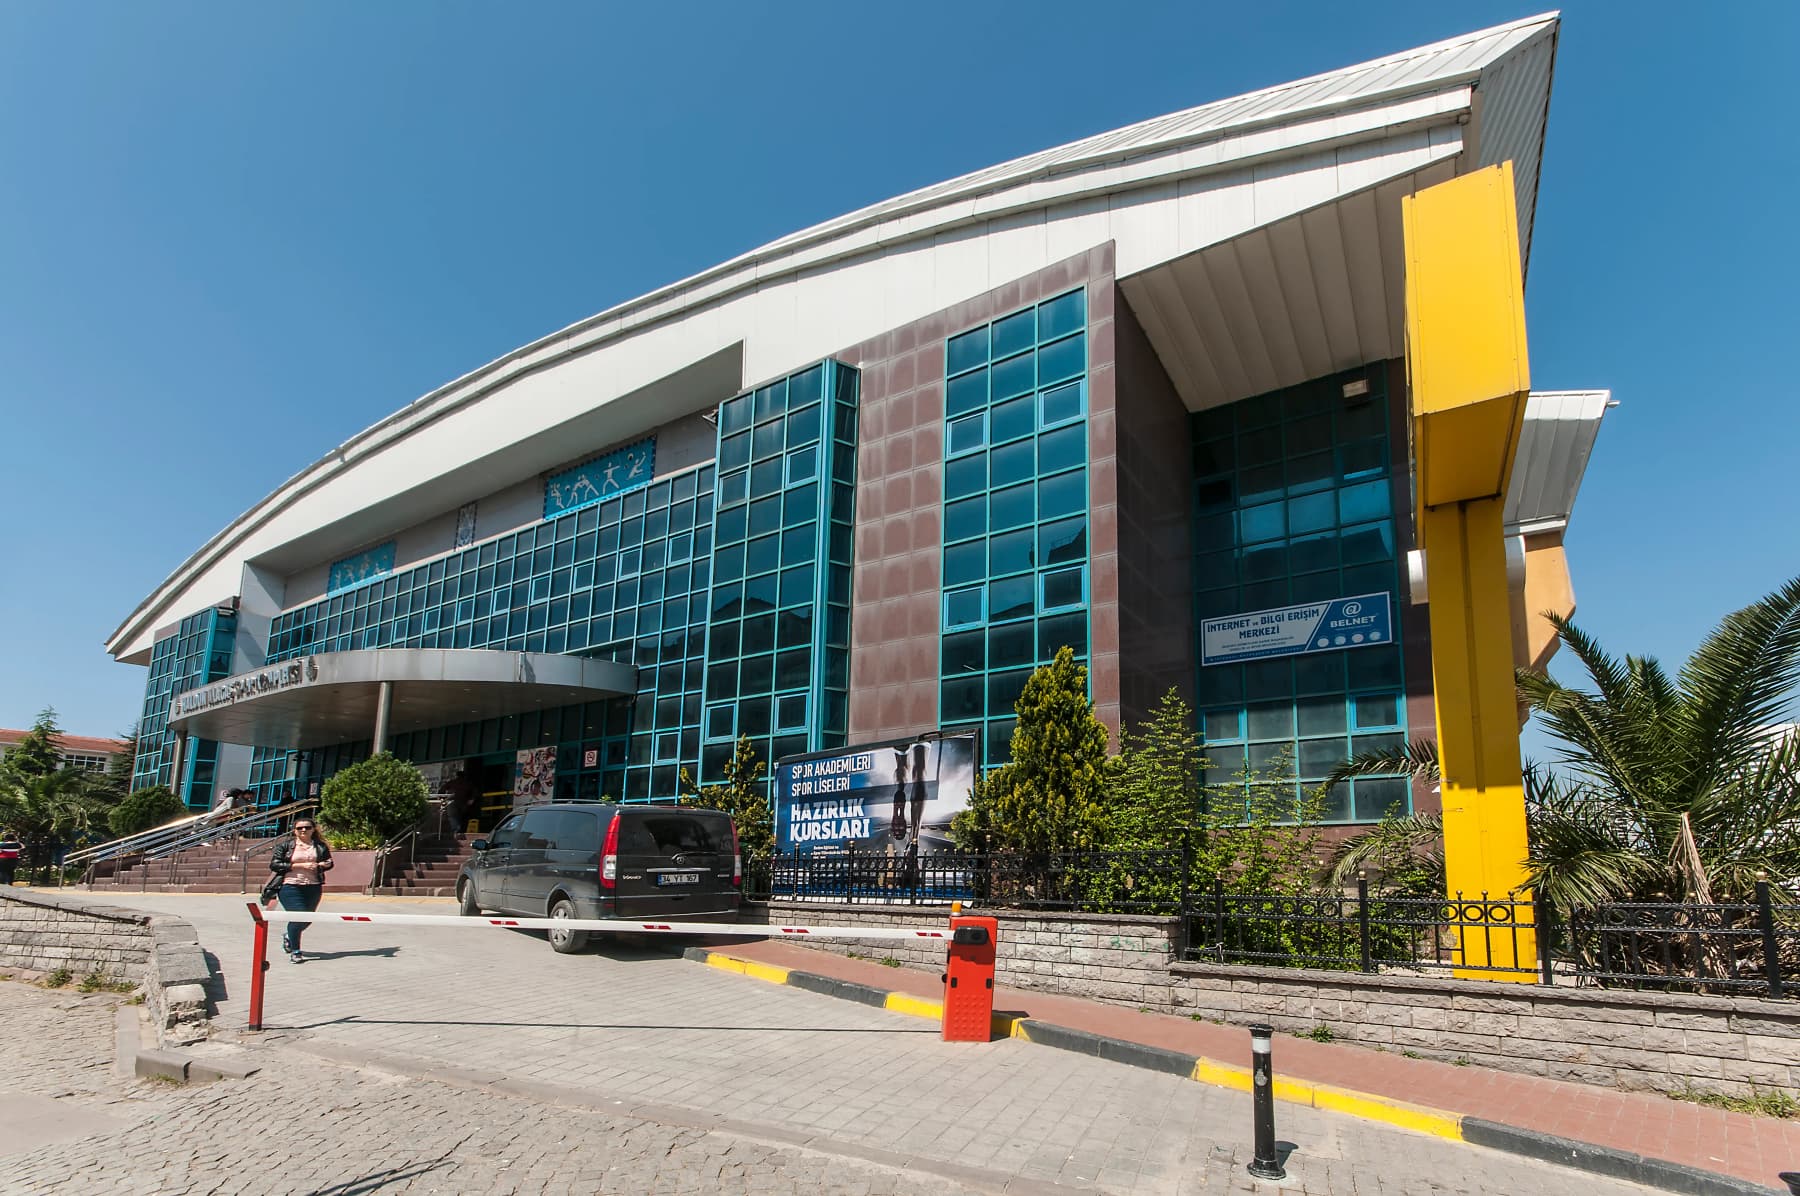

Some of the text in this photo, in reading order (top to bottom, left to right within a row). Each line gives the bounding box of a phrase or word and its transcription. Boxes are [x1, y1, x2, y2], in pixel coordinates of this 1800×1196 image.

[1260, 612, 1285, 625] BİLGİ
[1287, 608, 1320, 621] ERİŞİM
[1330, 615, 1377, 628] BELNET
[1239, 625, 1280, 639] MERKEZİ
[792, 753, 871, 779] SPOR AKADEMİLERİ
[791, 774, 850, 797] SPOR LİSELERİ
[790, 798, 864, 821] HAZIRLIK
[789, 818, 870, 842] KURSLARI
